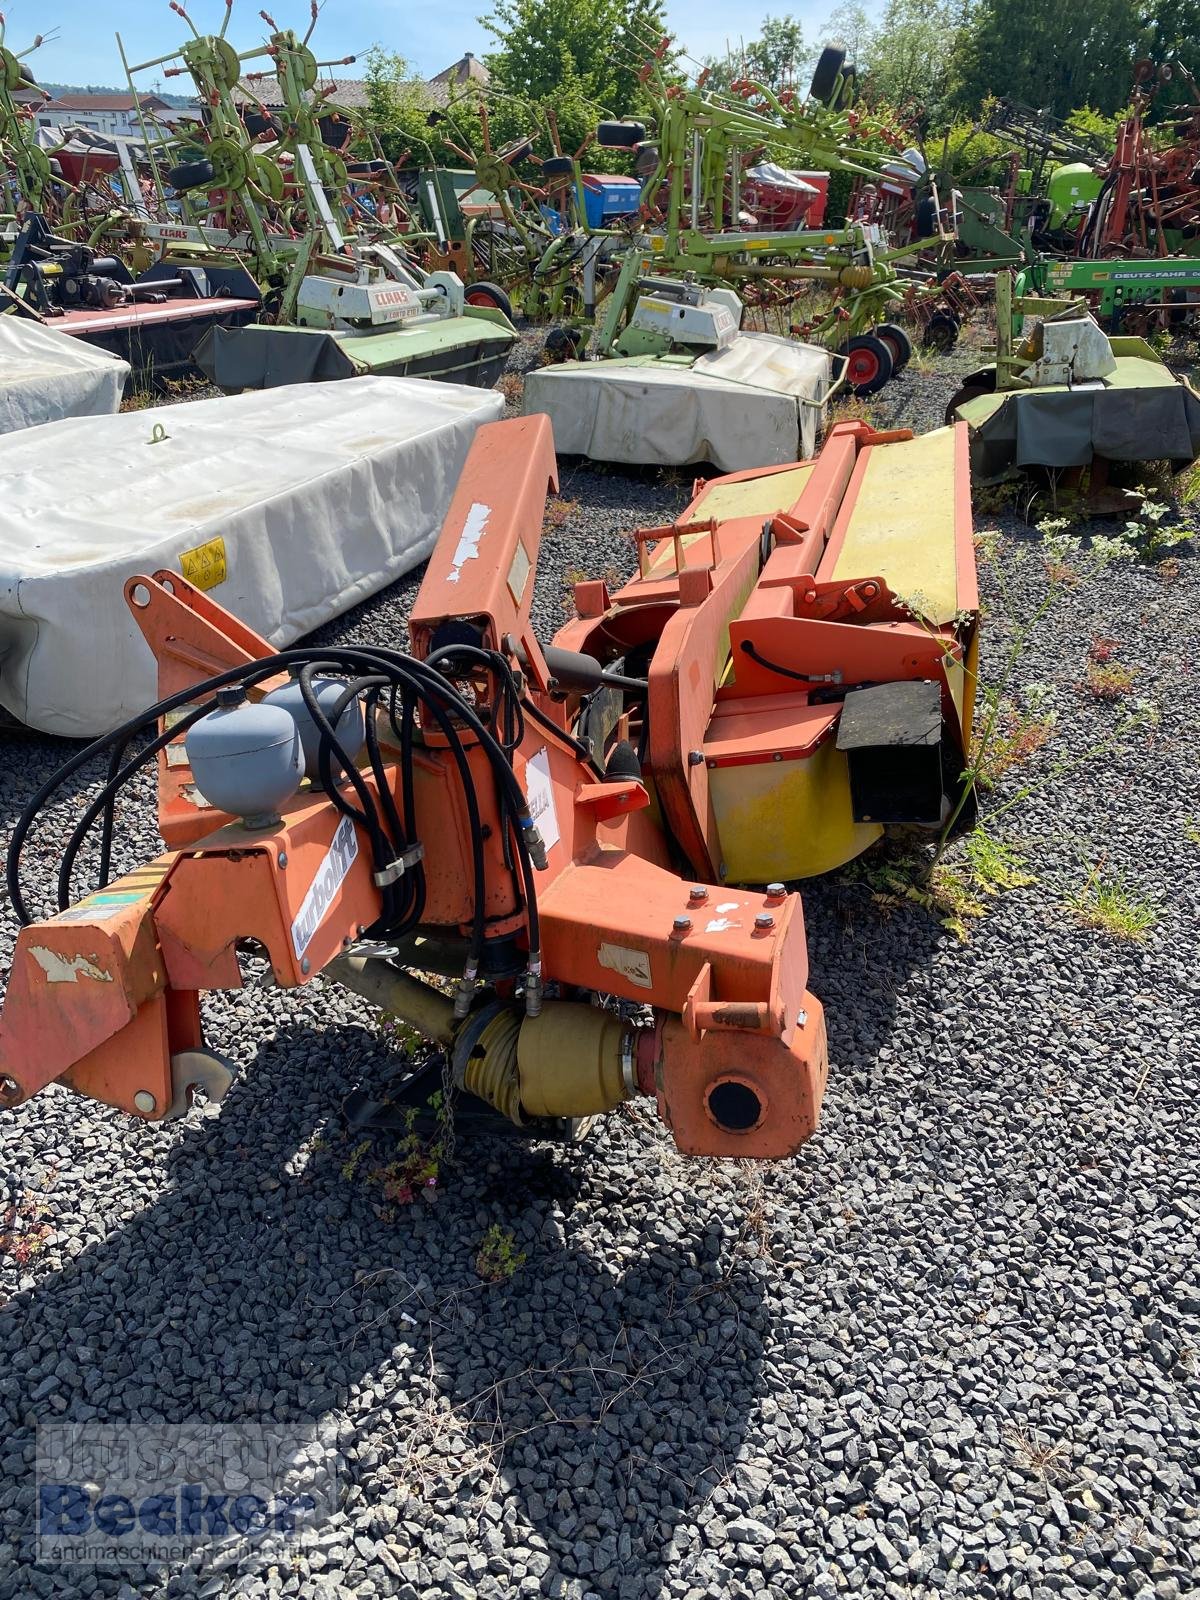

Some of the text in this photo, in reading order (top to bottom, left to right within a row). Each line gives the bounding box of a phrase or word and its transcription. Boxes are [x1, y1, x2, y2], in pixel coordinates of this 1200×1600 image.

[160, 229, 188, 239] CLAAS
[1114, 271, 1187, 279] DEUTZ-FAHR
[375, 290, 409, 306] CLAAS
[296, 819, 356, 951] turbolift
